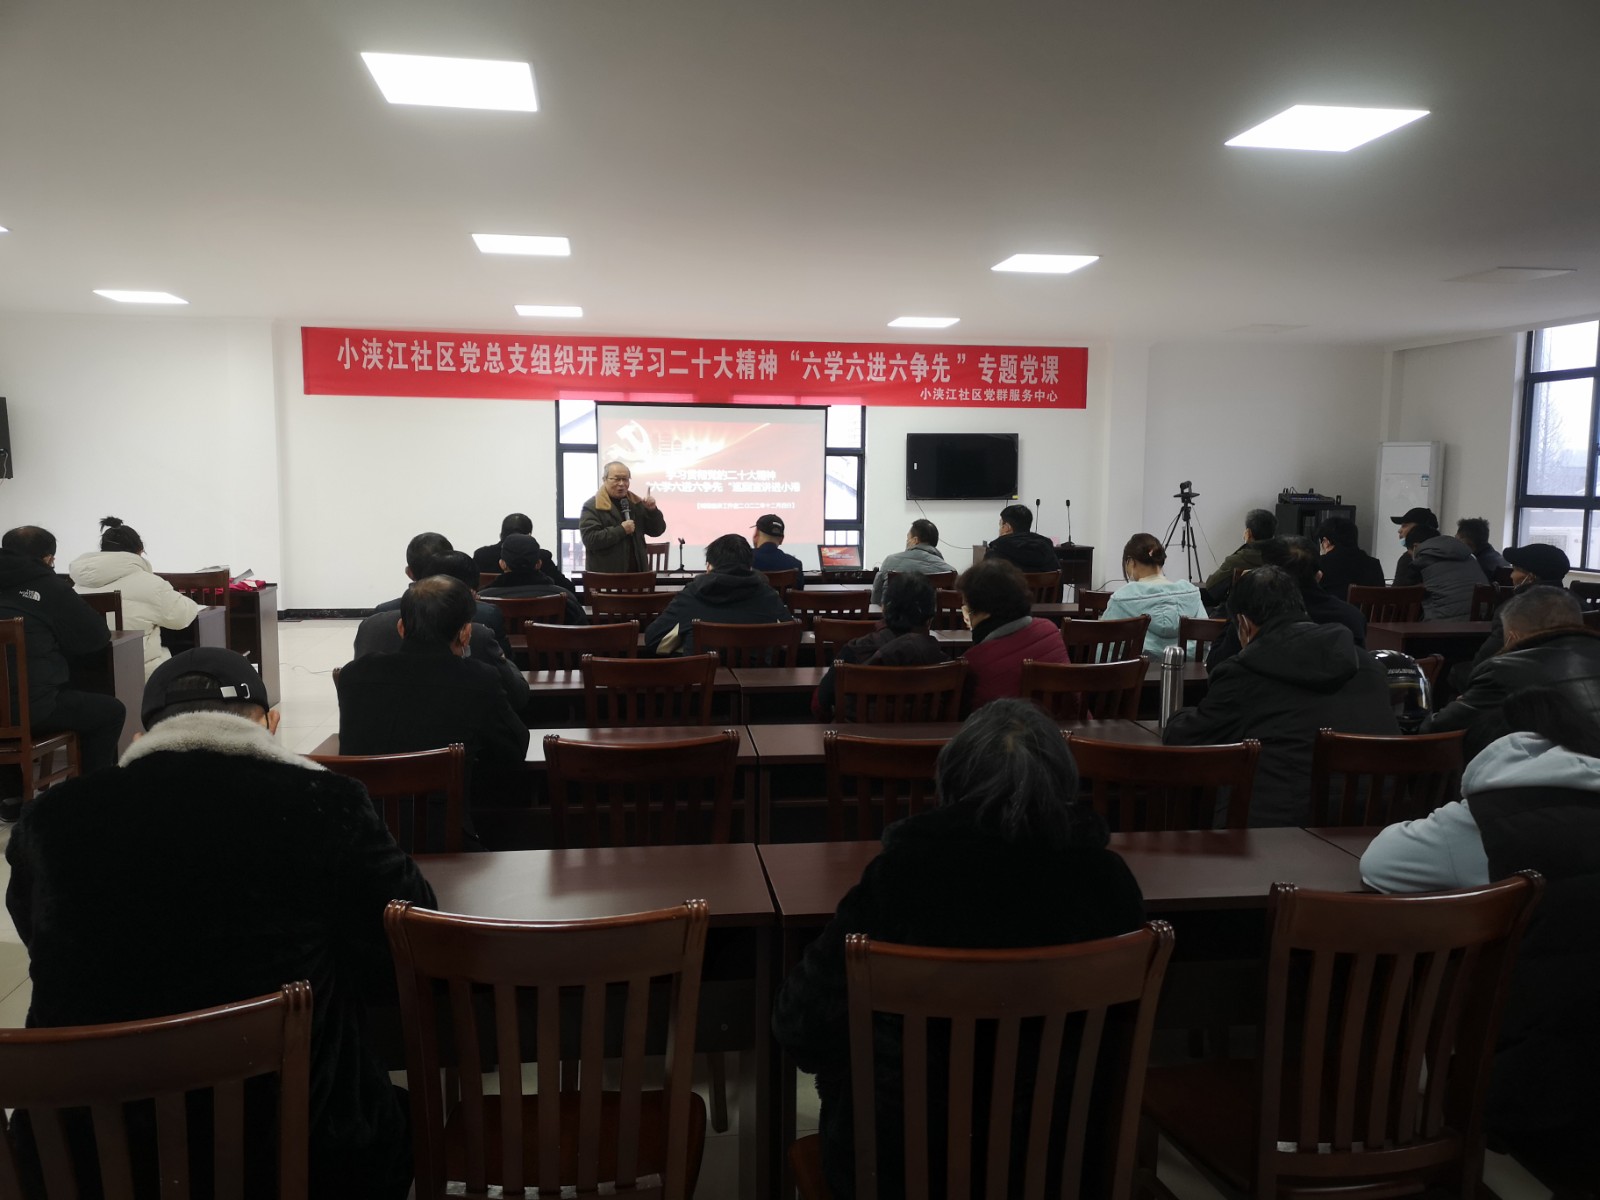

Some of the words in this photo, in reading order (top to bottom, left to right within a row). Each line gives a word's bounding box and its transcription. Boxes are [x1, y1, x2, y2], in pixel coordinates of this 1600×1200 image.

[920, 387, 1058, 402] 小浃江社区党群服务中心
